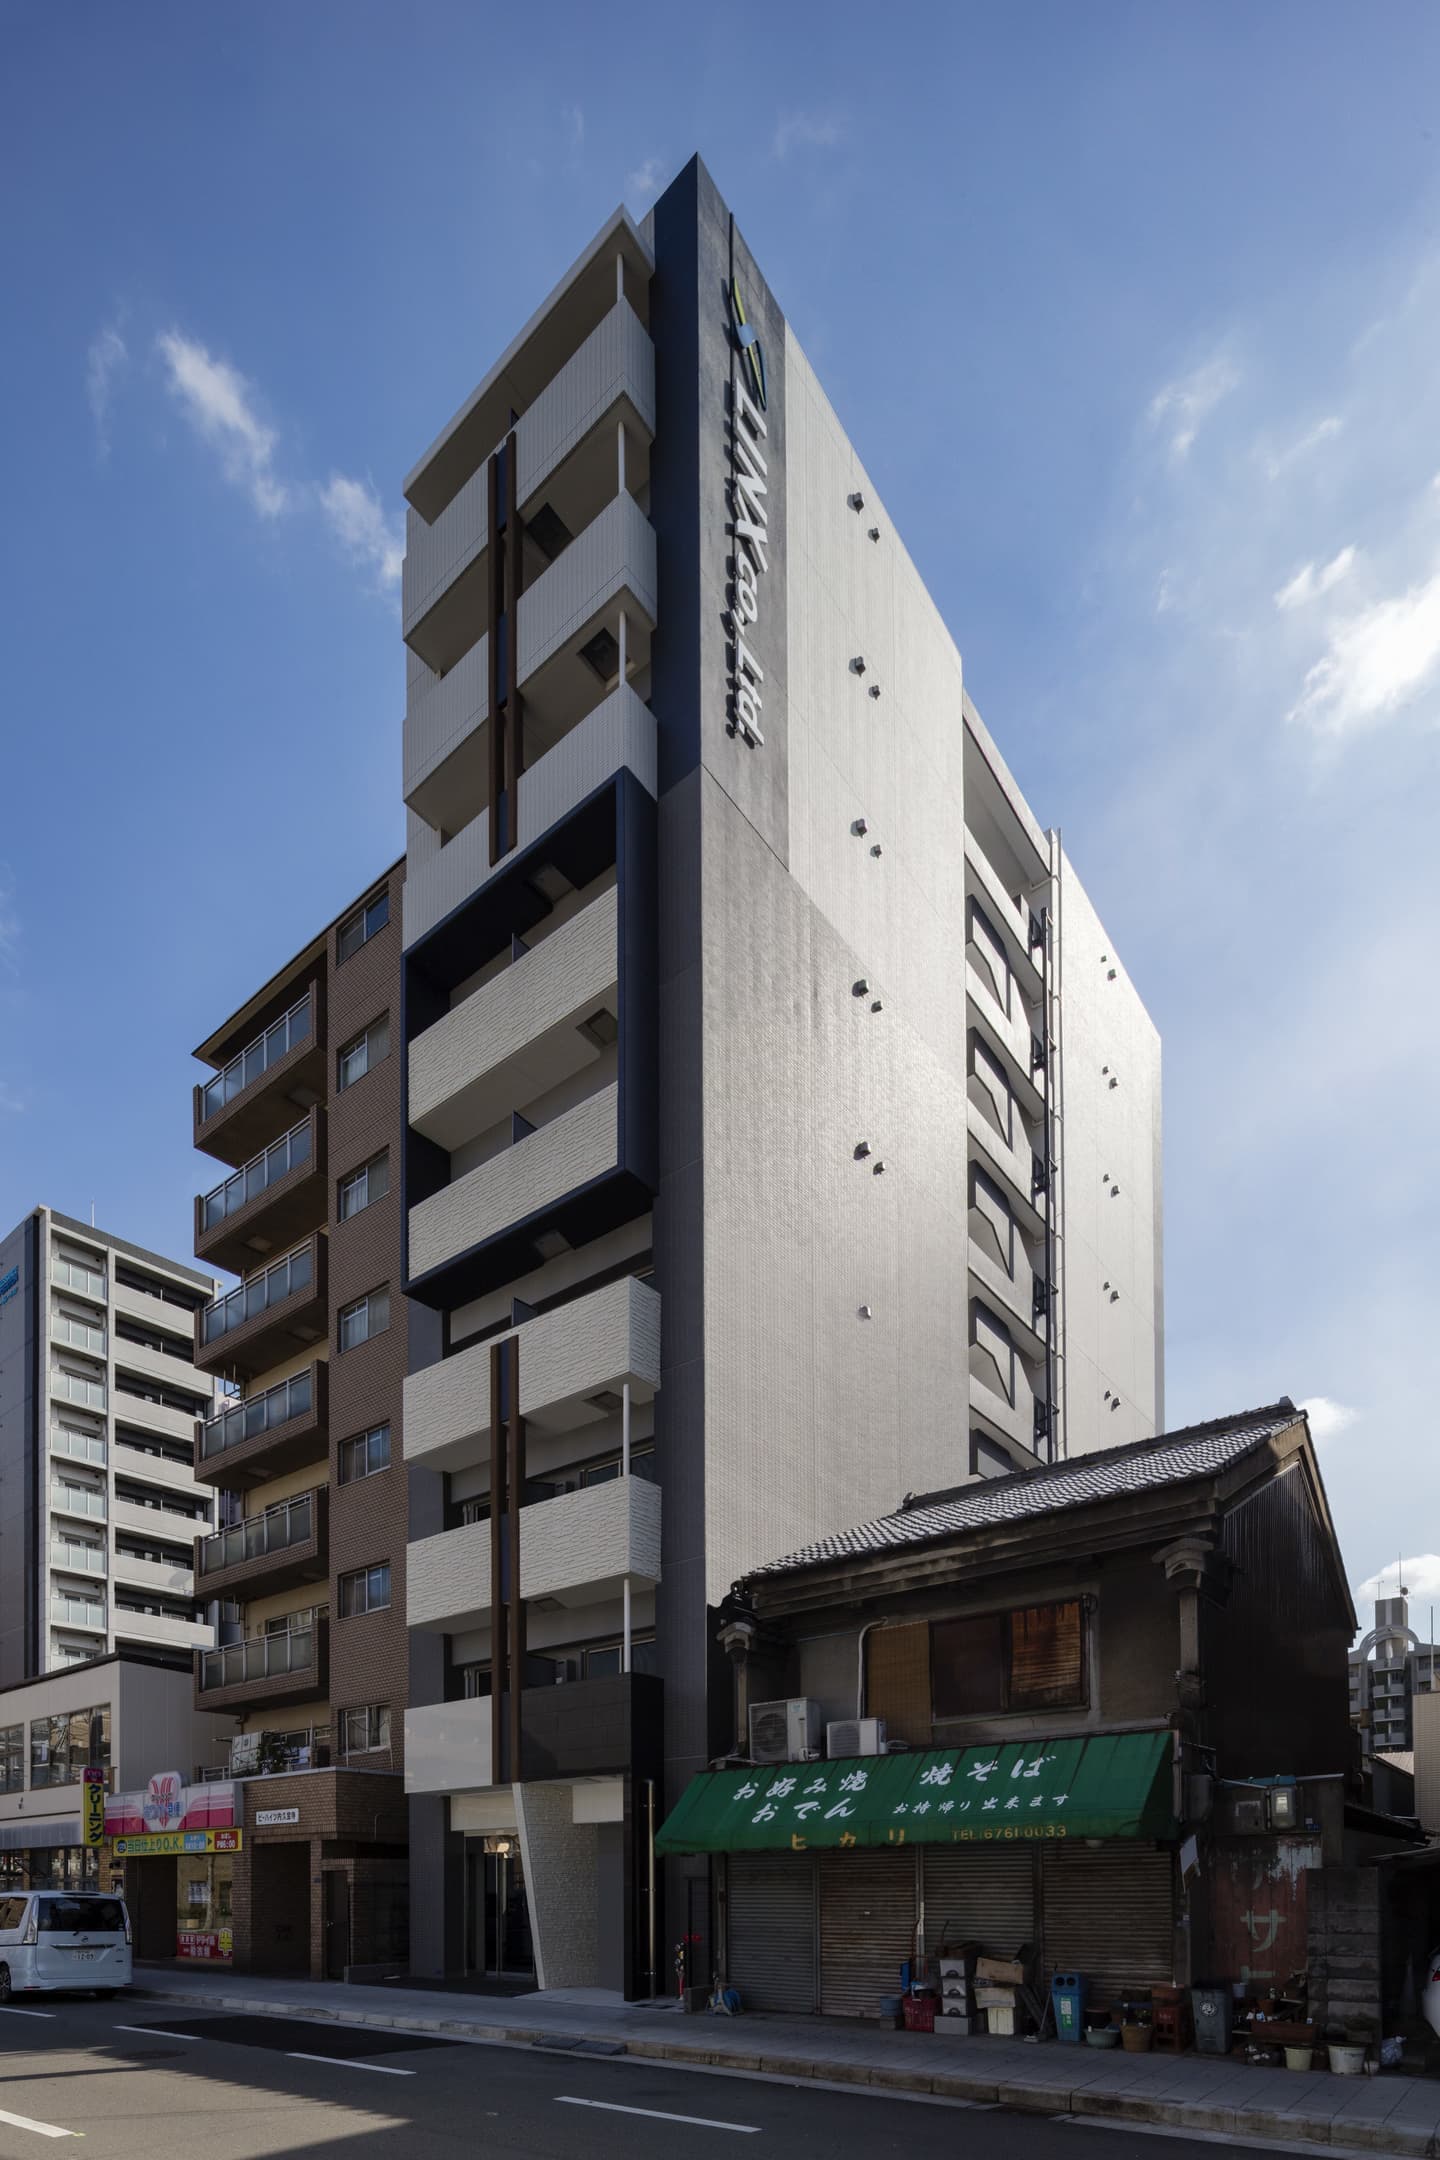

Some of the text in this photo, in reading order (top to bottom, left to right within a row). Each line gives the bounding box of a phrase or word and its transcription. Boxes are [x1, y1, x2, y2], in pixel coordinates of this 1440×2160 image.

[736, 376, 769, 575] LINX
[732, 1754, 1057, 1801] お好み焼 焼そば
[88, 1783, 102, 1843] クリーニング
[751, 1793, 1069, 1823] おでん お持帰り出来ます
[791, 1828, 906, 1851] ヒカリ
